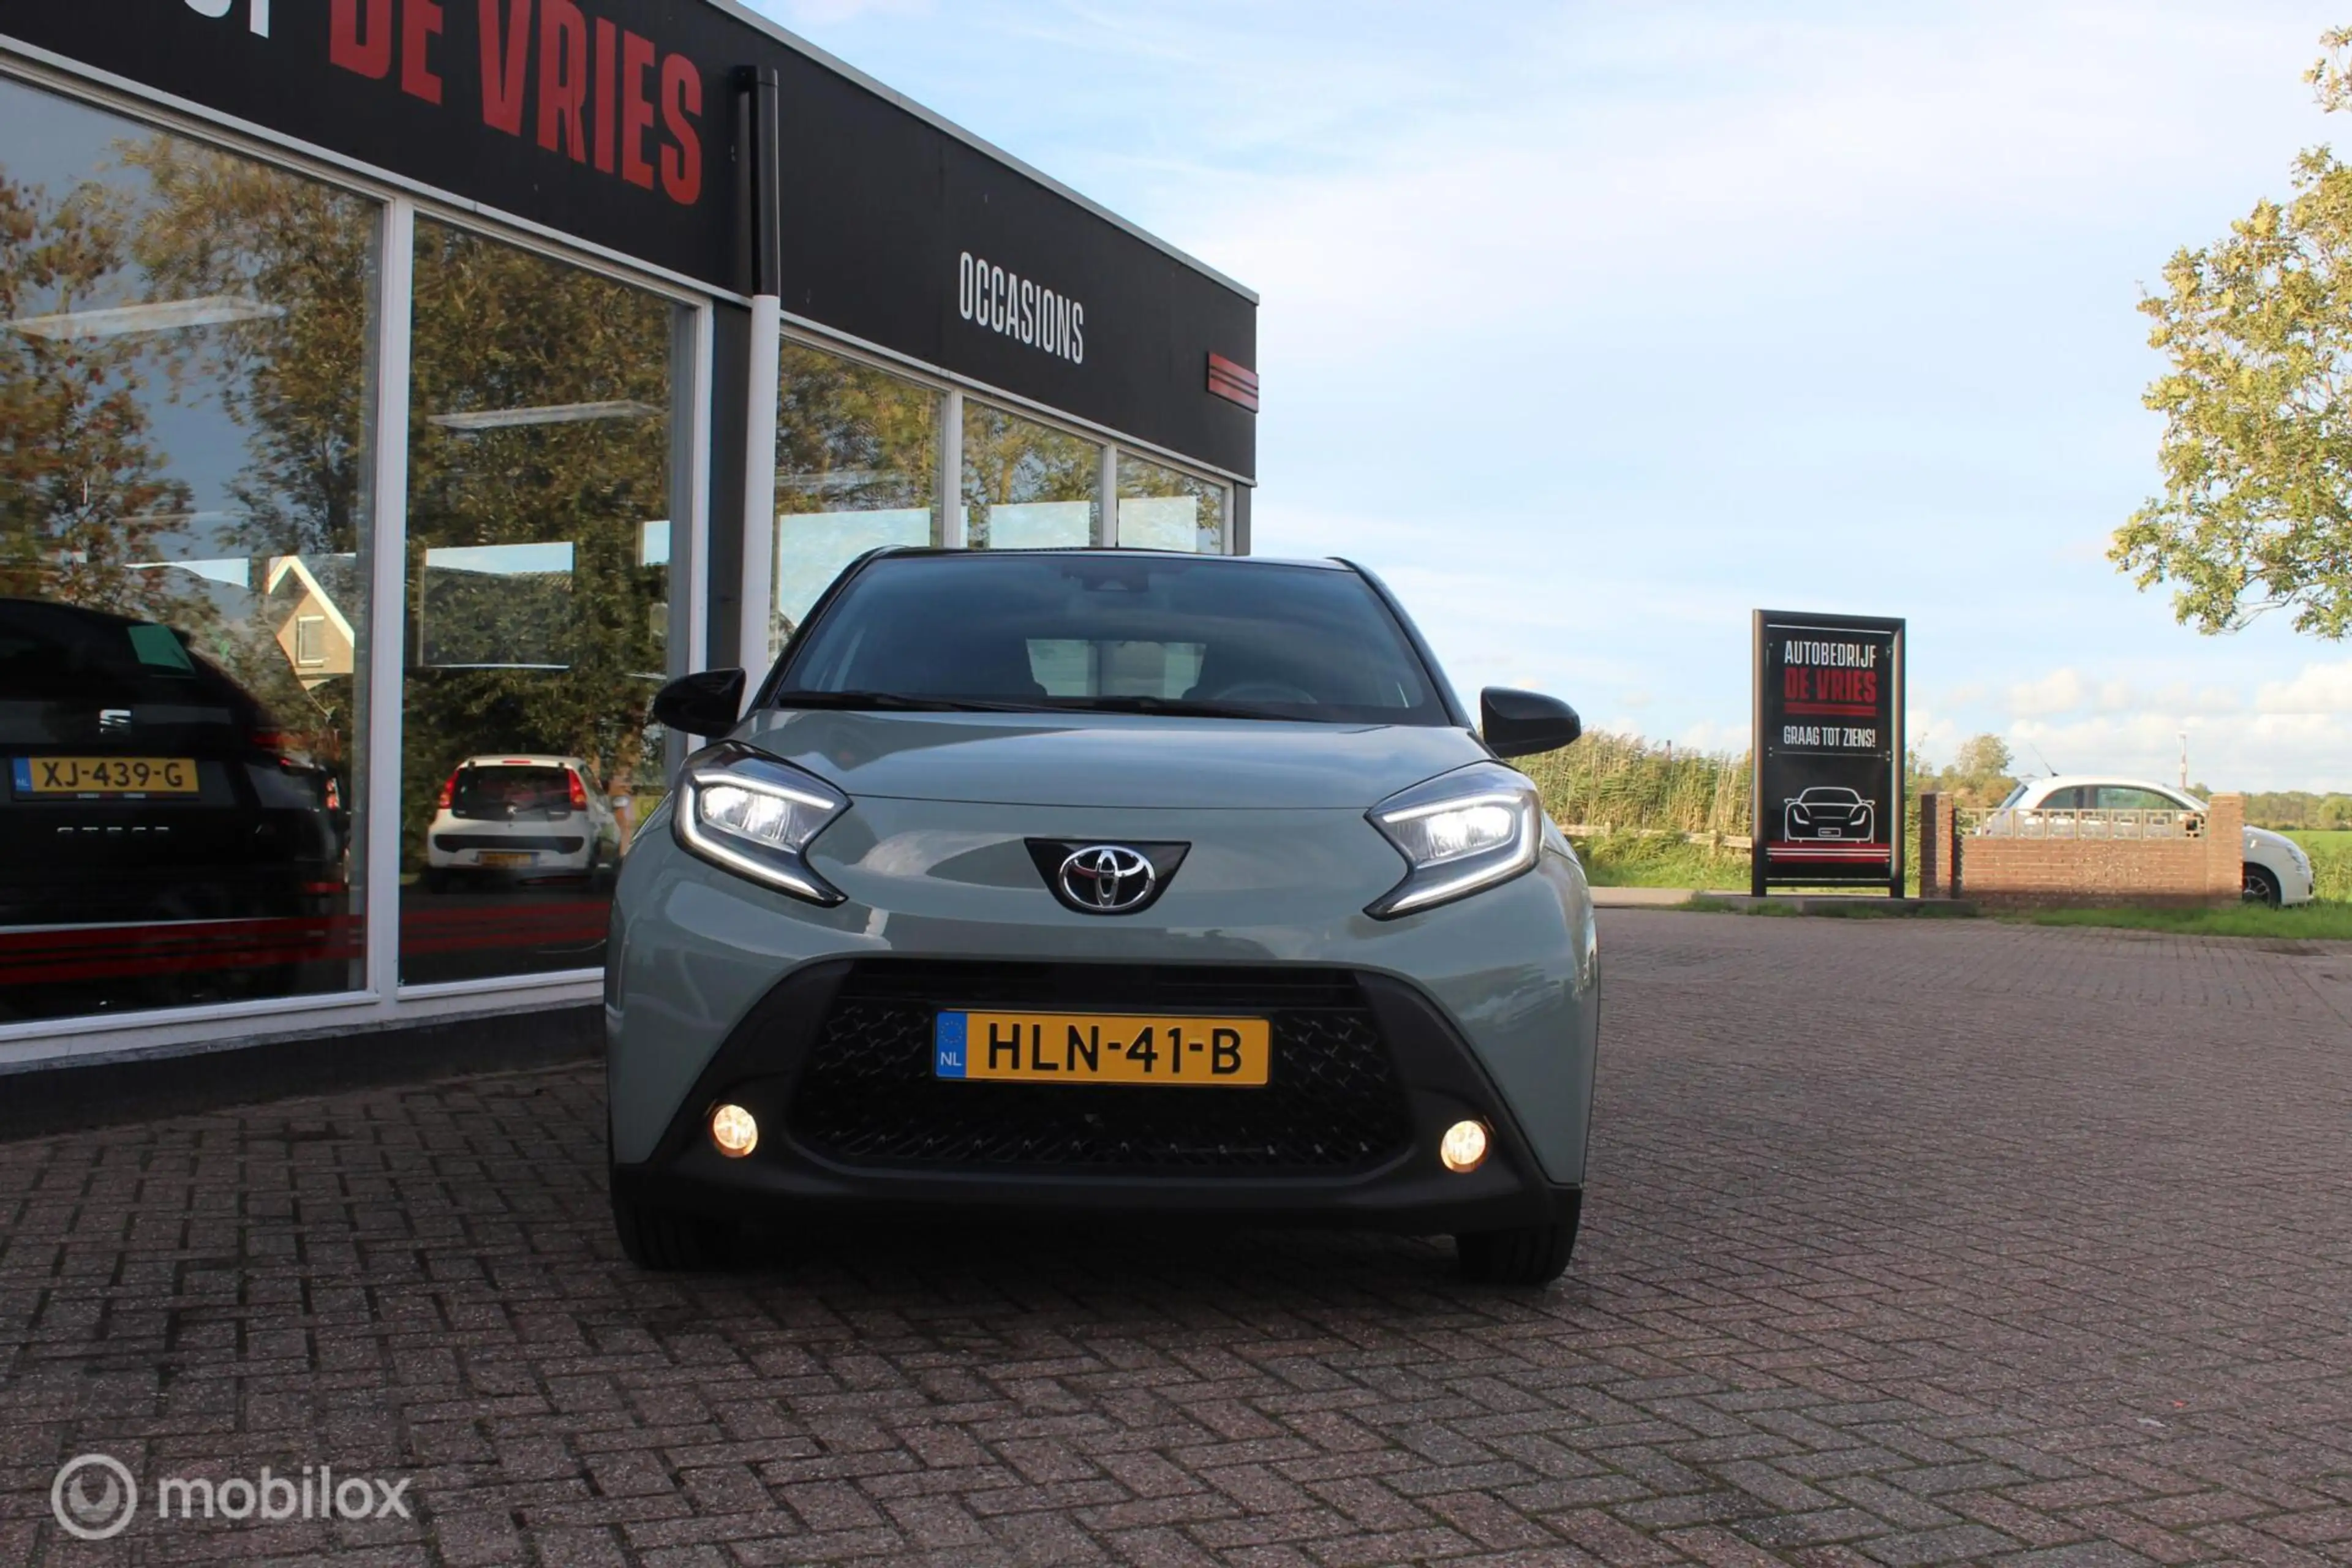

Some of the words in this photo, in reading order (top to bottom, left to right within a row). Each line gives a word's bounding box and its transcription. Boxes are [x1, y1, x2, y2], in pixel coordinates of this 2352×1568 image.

[478, 0, 702, 205] VRIES
[960, 251, 1084, 364] OCCASIONS
[1784, 640, 1877, 668] AUTOBEDRIJF
[1784, 666, 1809, 699] DE
[1816, 668, 1877, 703] VRIES
[1783, 725, 1820, 745] GRAAG
[1822, 727, 1840, 746] TOT
[1843, 727, 1876, 748] ZIENS!
[42, 761, 183, 788] XJ-439-G
[940, 1052, 962, 1067] NL
[988, 1022, 1242, 1075] HLN-41-B
